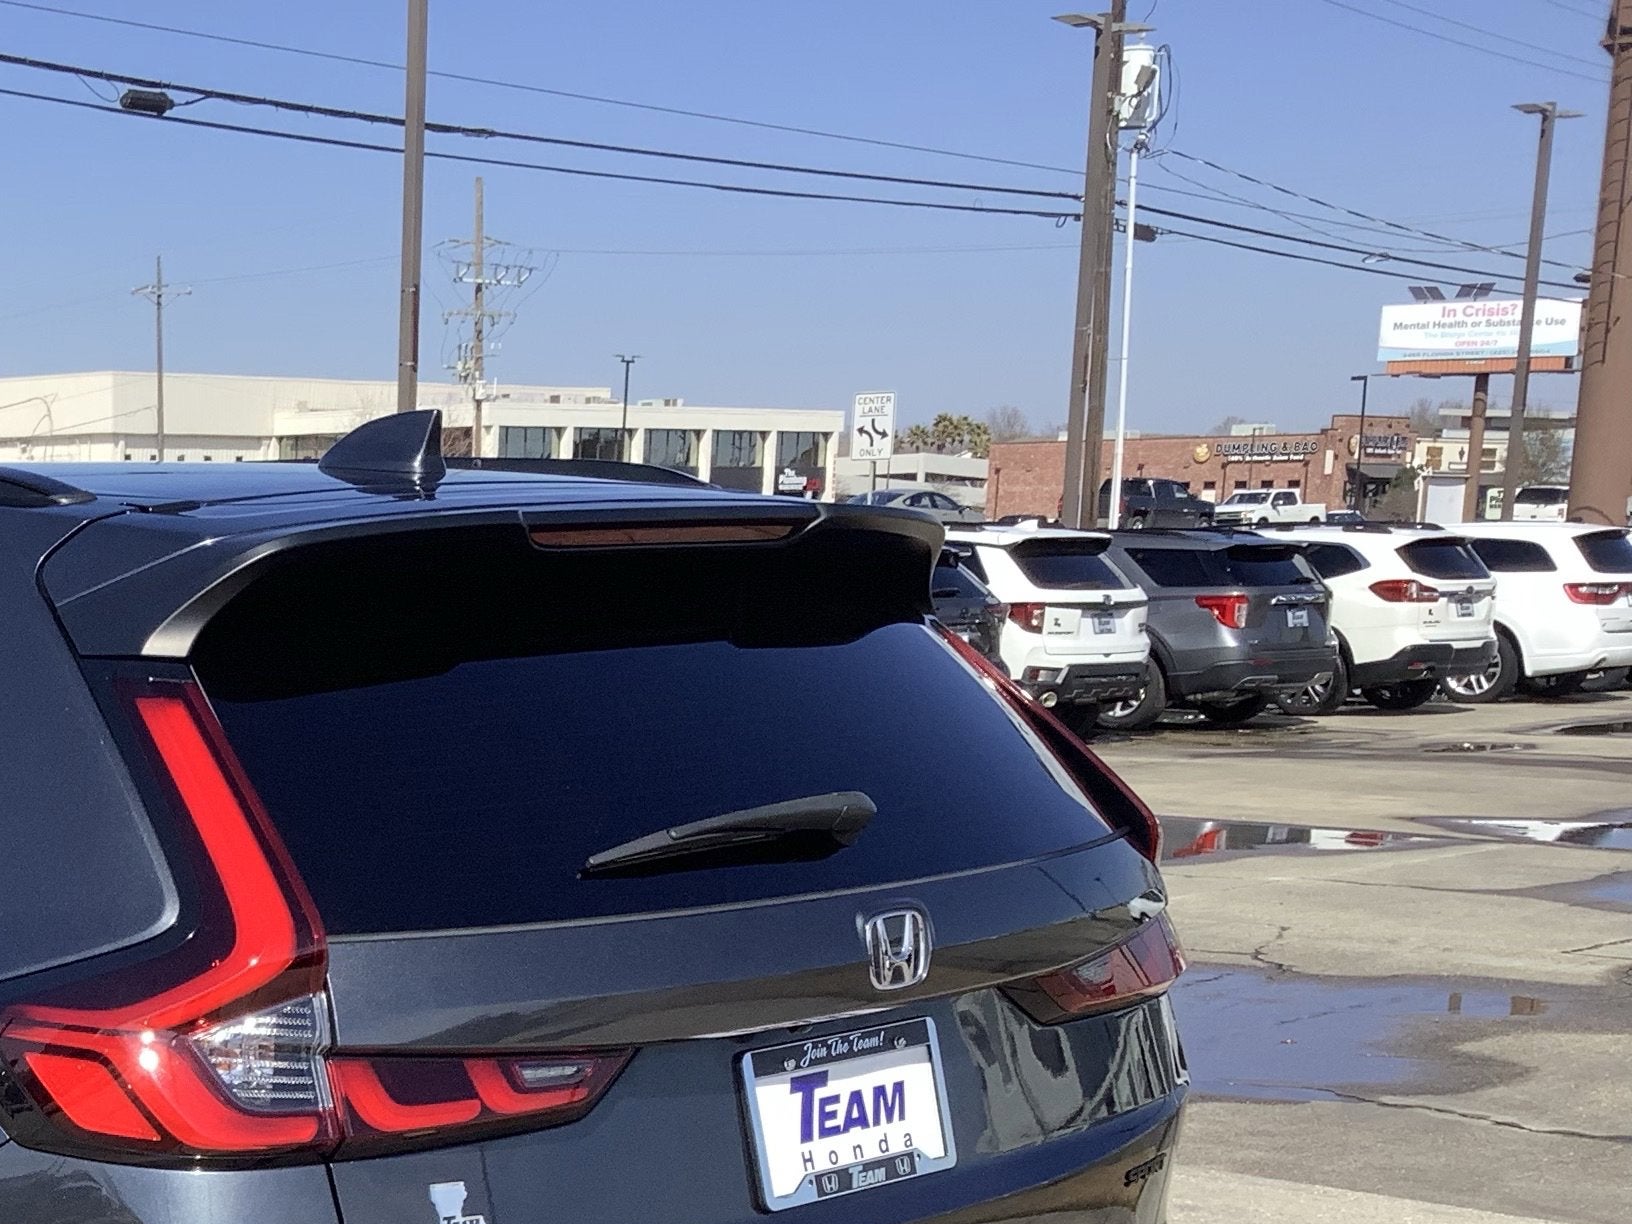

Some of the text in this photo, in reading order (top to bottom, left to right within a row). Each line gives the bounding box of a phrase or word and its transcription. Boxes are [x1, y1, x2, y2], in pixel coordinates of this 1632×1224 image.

[1441, 303, 1518, 318] In Crisis?
[1393, 320, 1430, 331] Mental
[1432, 319, 1468, 330] Health
[1485, 318, 1543, 328] Substae
[1545, 316, 1567, 326] Use
[1455, 339, 1499, 348] OPEN 24/7
[858, 395, 892, 406] CENTER
[862, 405, 886, 415] LANE
[859, 448, 883, 458] ONLY
[1215, 441, 1320, 456] DUMPLING & BAO
[800, 1030, 885, 1068] Join The Team!
[790, 1070, 906, 1144] TEAM
[801, 1132, 914, 1172] Honda
[848, 1164, 887, 1189] TEAM
